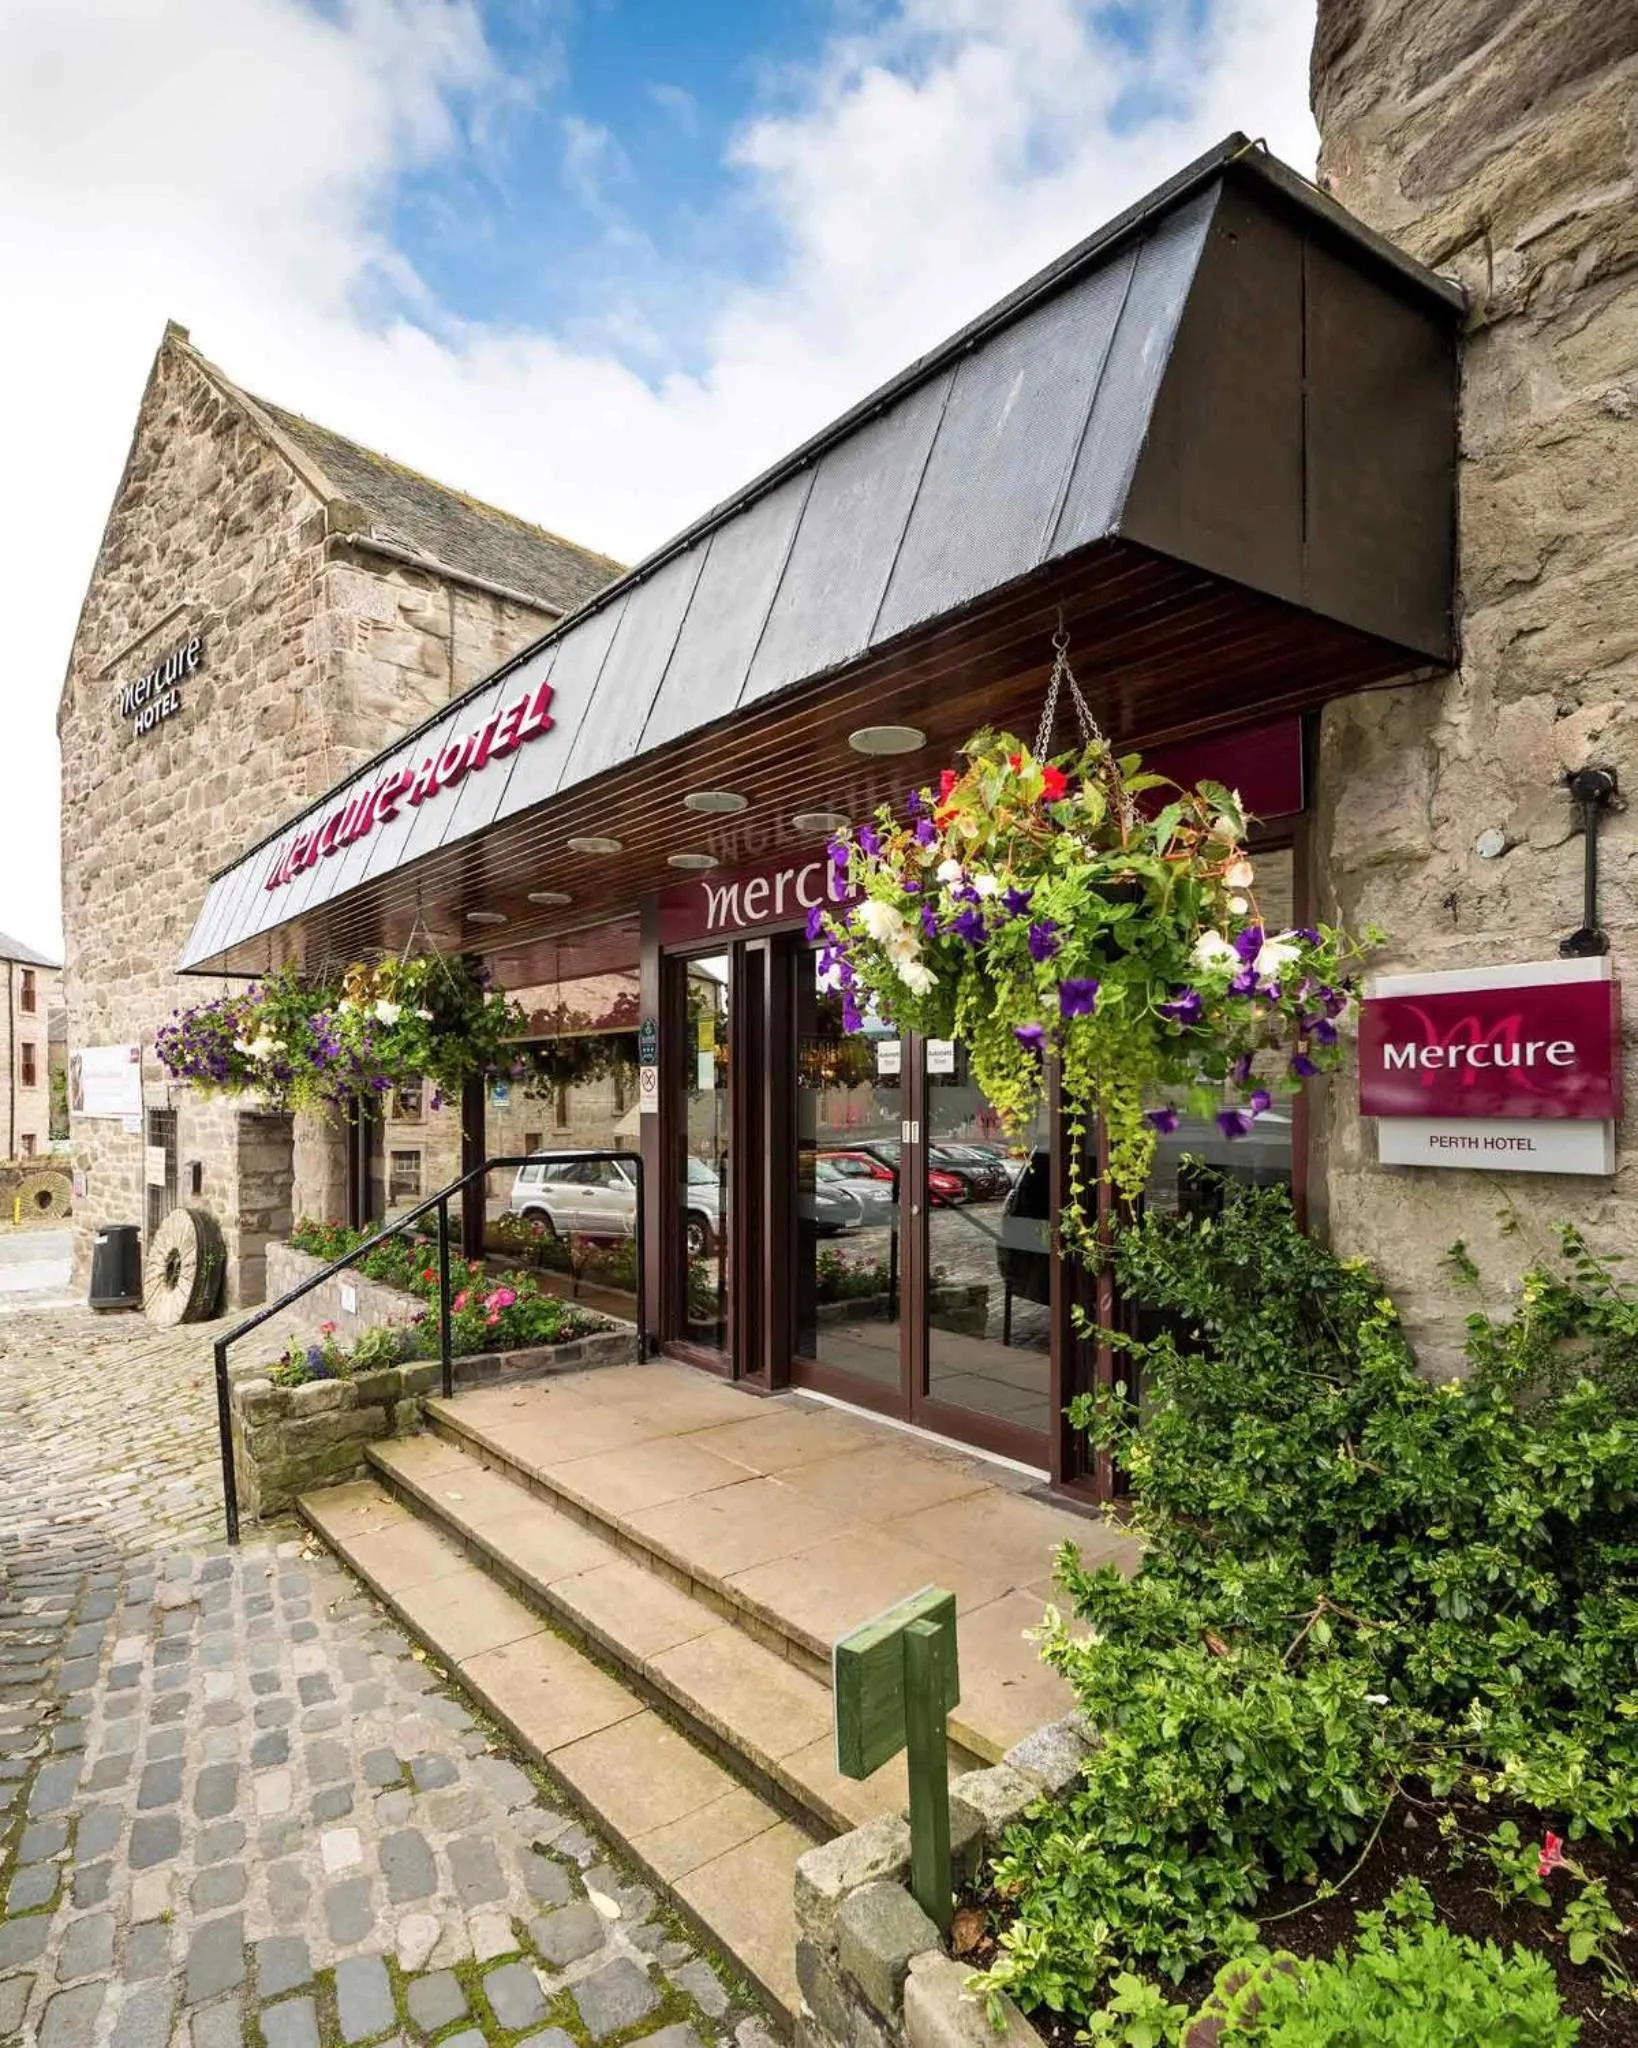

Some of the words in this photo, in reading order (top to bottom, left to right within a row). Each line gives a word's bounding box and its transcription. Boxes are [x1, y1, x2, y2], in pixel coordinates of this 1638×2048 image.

[134, 687, 180, 737] HOTEL
[408, 681, 556, 806] HOTEL
[1383, 1040, 1577, 1070] Mercure
[1429, 1135, 1480, 1150] PERTH
[1483, 1137, 1537, 1152] HOTEL
